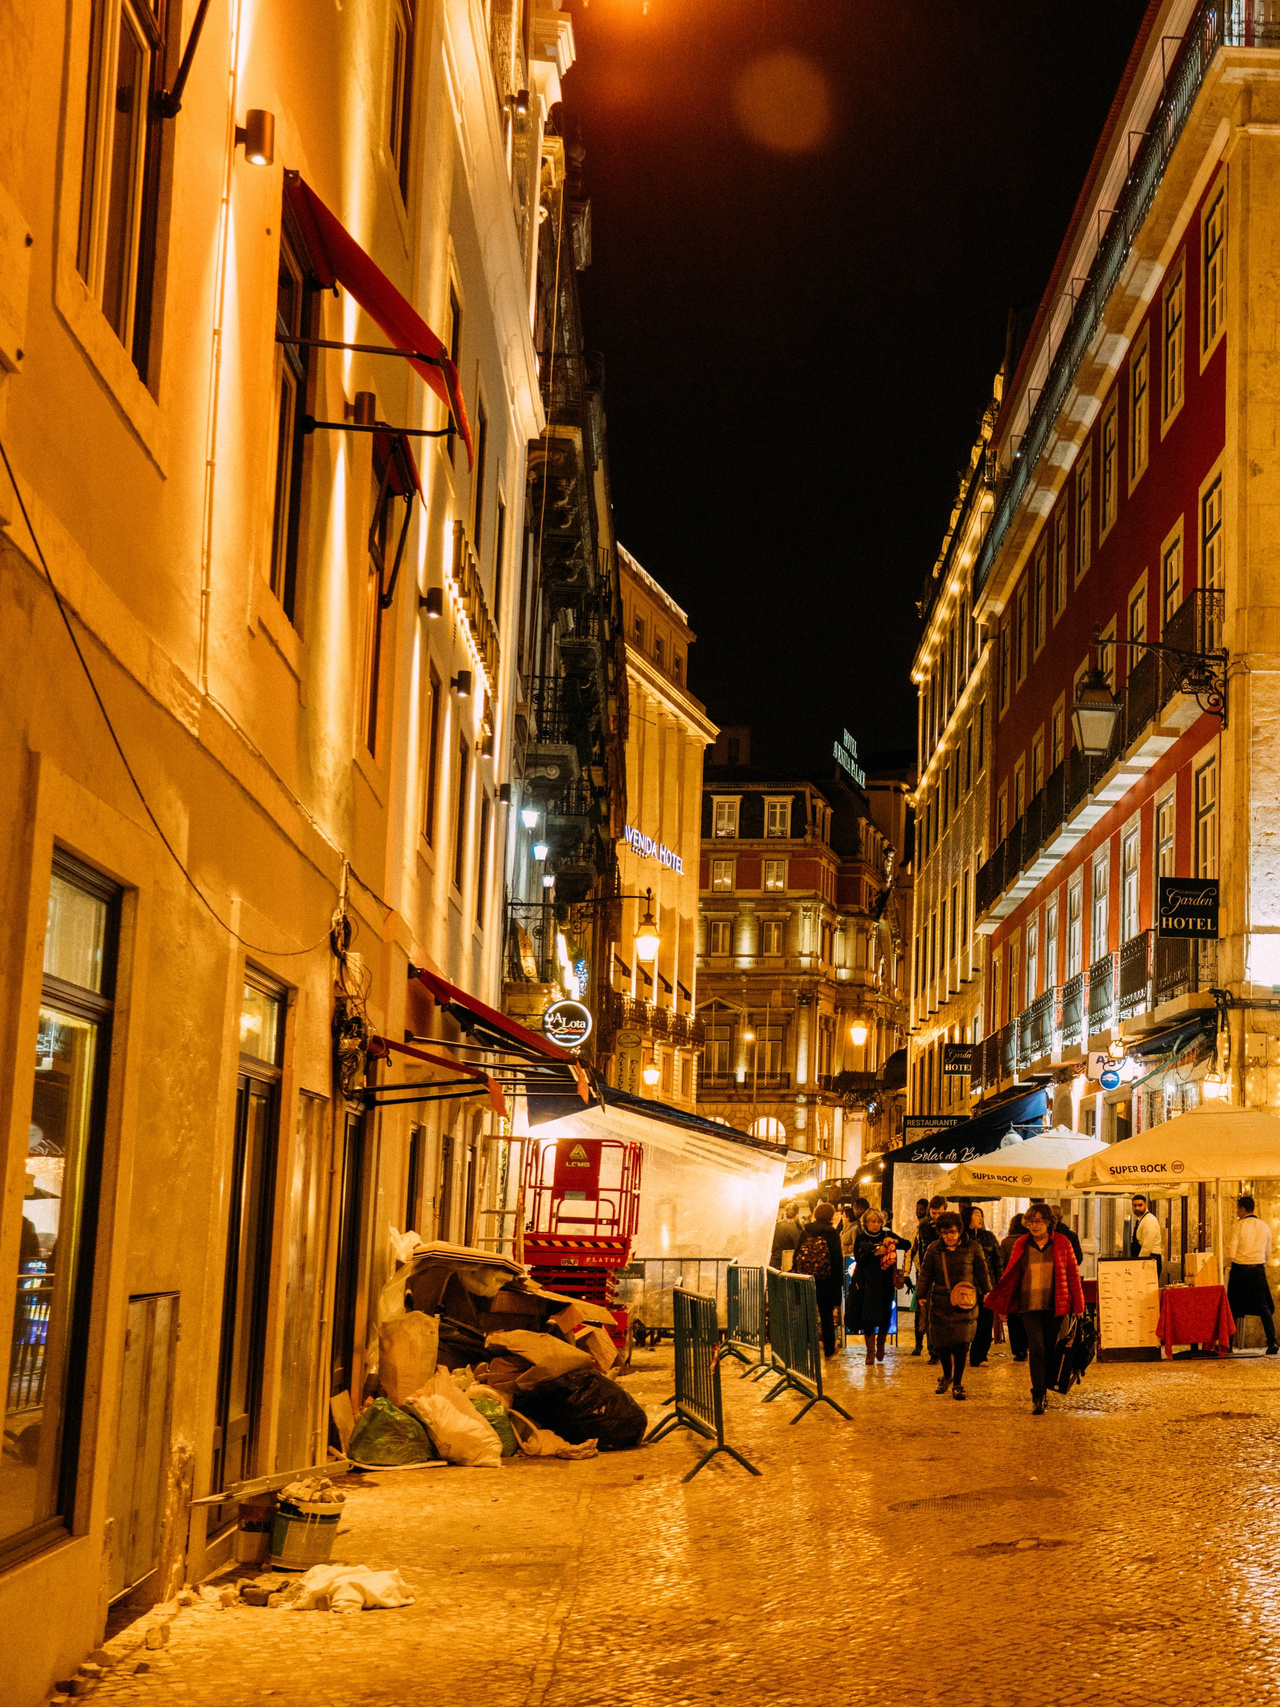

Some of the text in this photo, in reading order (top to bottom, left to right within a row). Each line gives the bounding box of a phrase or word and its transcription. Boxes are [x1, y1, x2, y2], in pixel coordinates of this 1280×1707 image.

[843, 728, 858, 759] HOTEL
[658, 842, 685, 876] HOTEL
[1160, 887, 1217, 915] Garden
[1161, 916, 1217, 930] HOTEL
[562, 1017, 587, 1029] Lota
[1109, 1165, 1139, 1175] SUPER
[1140, 1163, 1167, 1173] BOCK
[971, 1172, 996, 1180] SUPER
[996, 1174, 1018, 1183] BOCK
